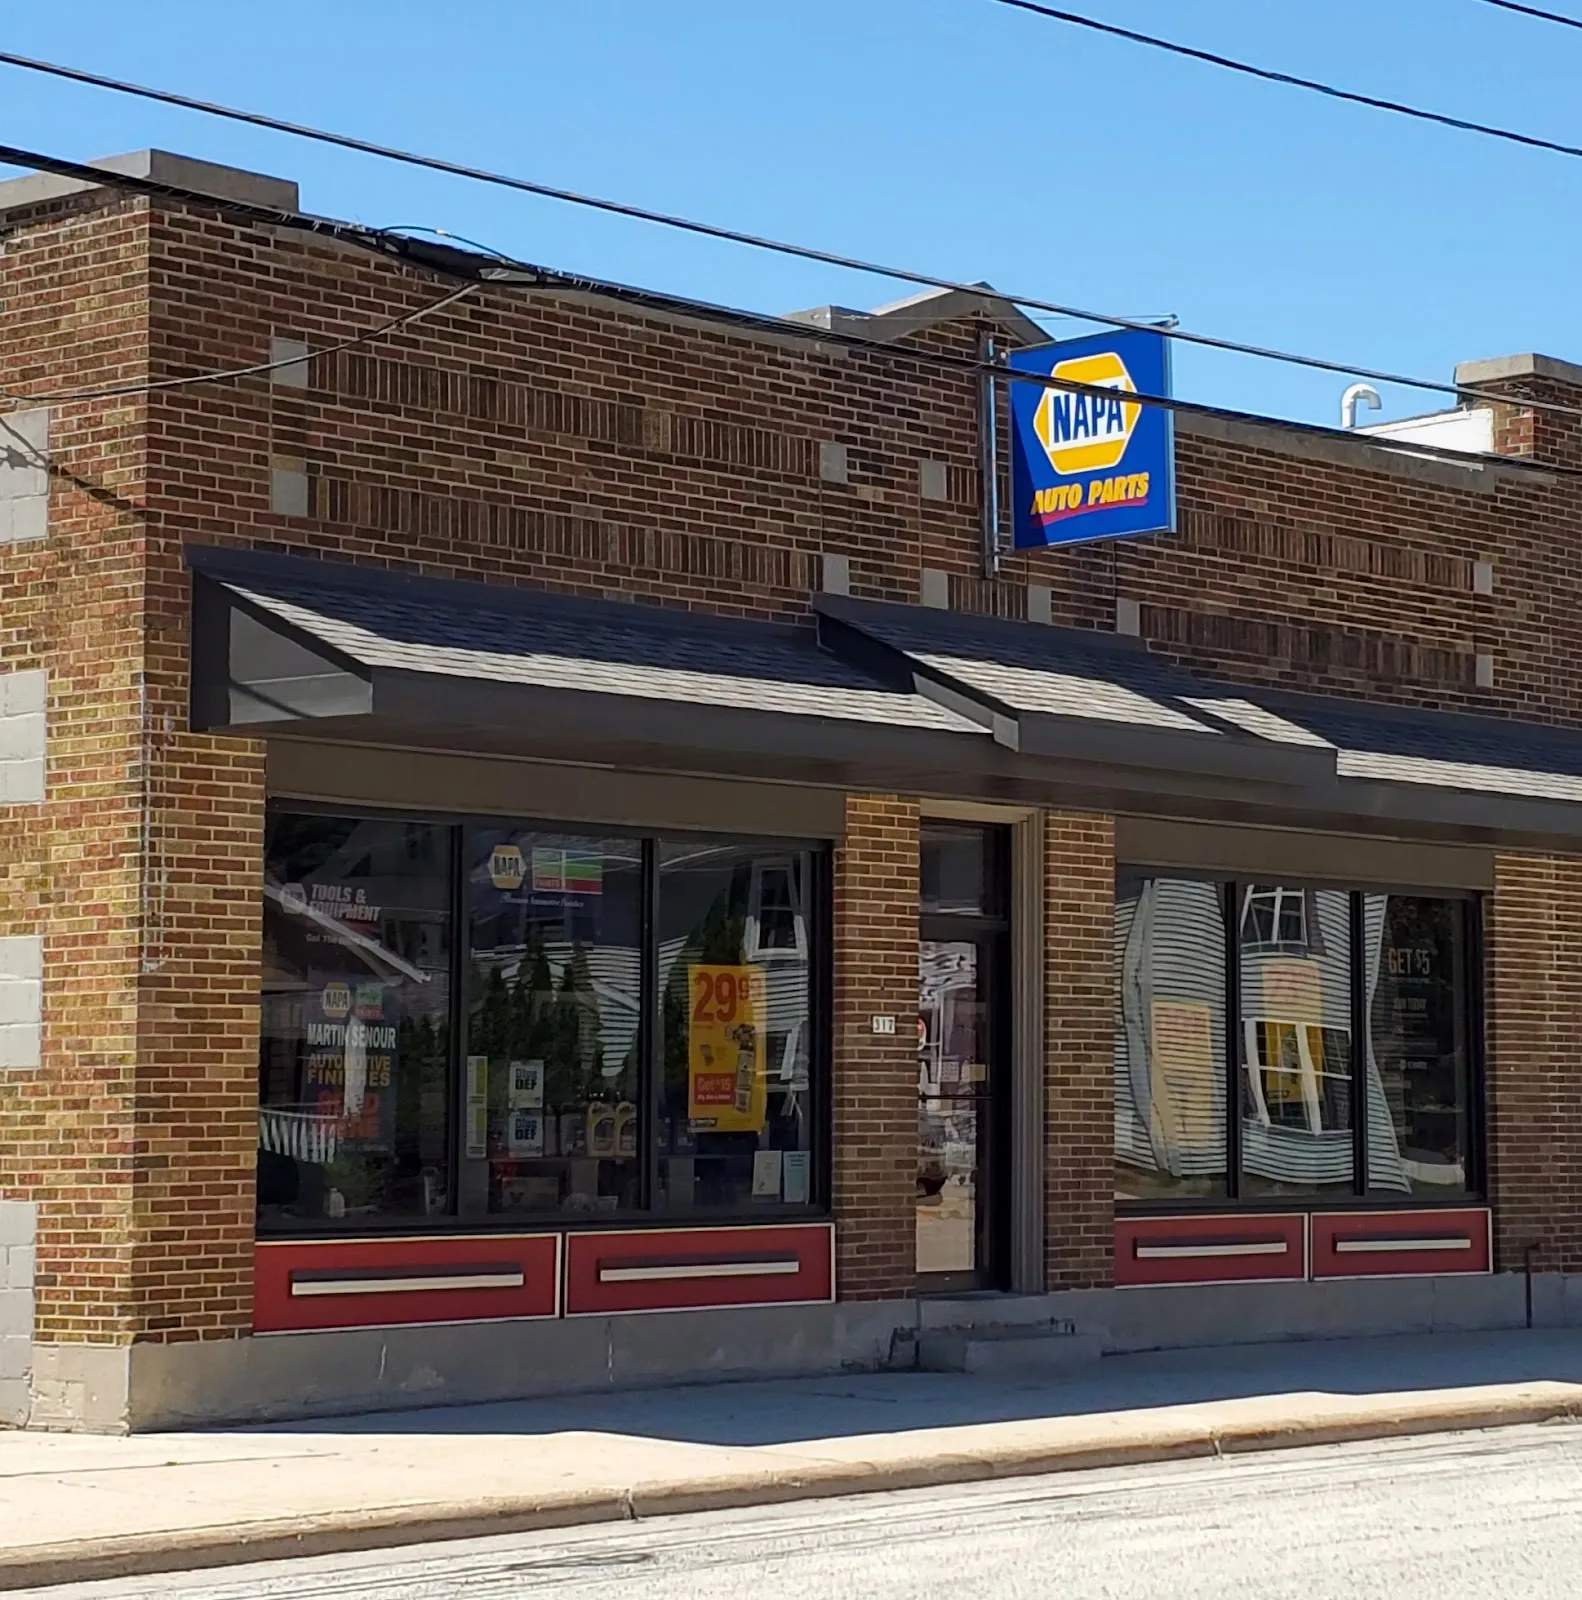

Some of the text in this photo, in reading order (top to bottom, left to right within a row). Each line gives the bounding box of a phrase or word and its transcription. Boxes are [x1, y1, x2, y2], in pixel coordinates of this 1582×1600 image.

[1053, 384, 1124, 444] NAPA
[1030, 472, 1150, 515] AUTO PARTS
[311, 884, 352, 902] TOOLS
[355, 888, 367, 904] &
[308, 900, 382, 921] EQUIPMENT
[1388, 948, 1431, 976] GET $5
[324, 990, 349, 1009] NAPA
[874, 1018, 895, 1032] 317
[351, 1024, 396, 1049] SENOUR
[308, 1052, 392, 1073] AUTOOIVE
[308, 1069, 391, 1088] FINIES
